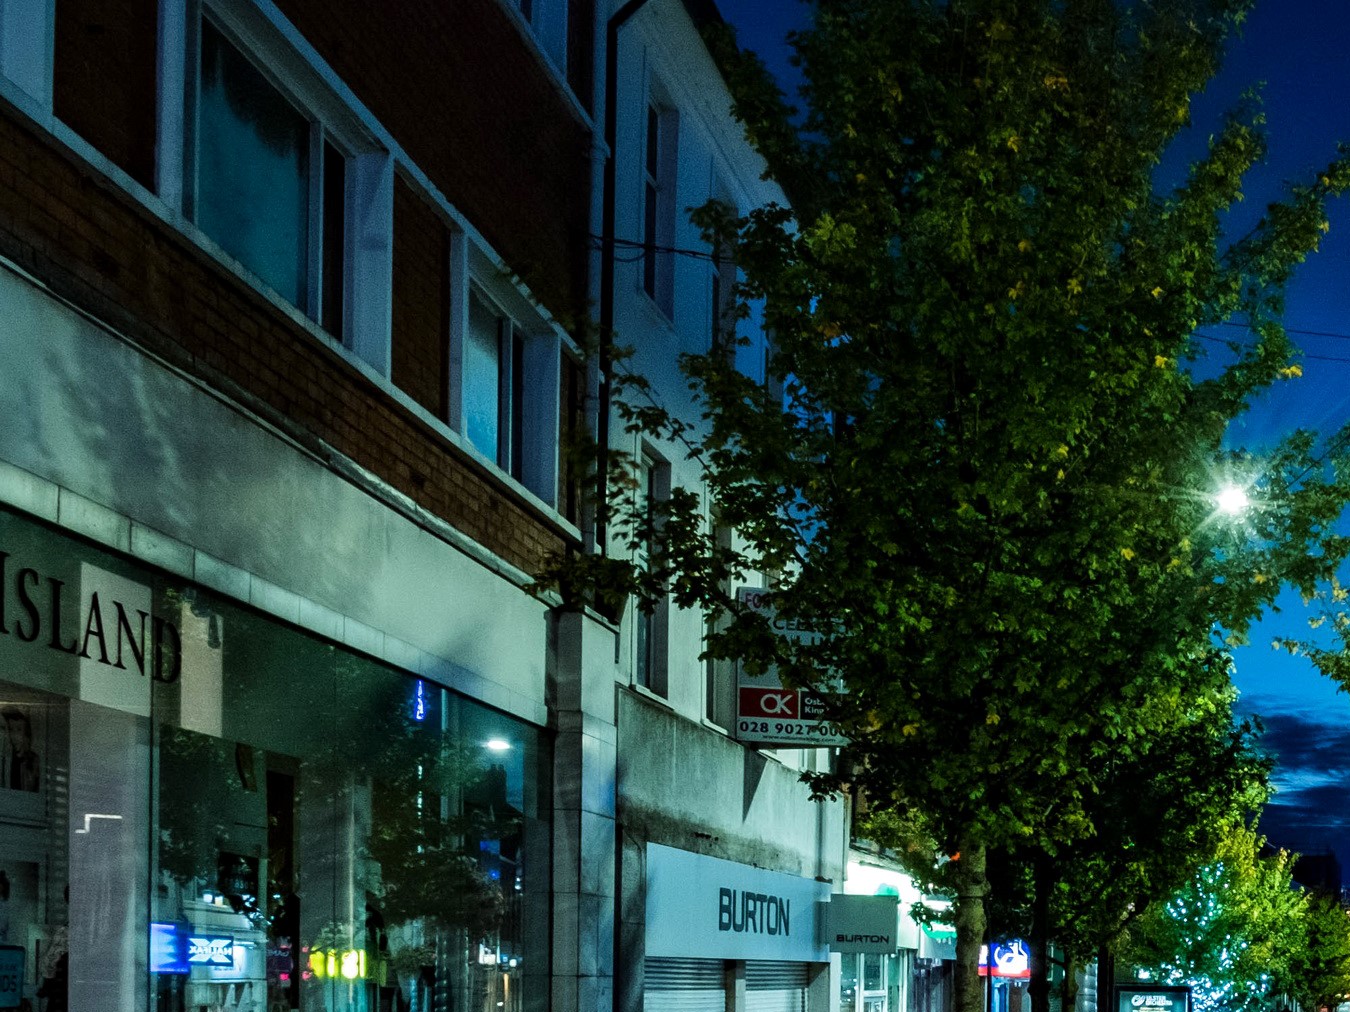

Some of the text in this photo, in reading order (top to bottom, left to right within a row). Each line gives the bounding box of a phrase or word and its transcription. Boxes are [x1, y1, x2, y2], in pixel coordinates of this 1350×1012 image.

[0, 552, 182, 683] ISLAND
[740, 721, 769, 733] 028
[718, 887, 790, 937] BURTON
[836, 934, 889, 944] BURTON
